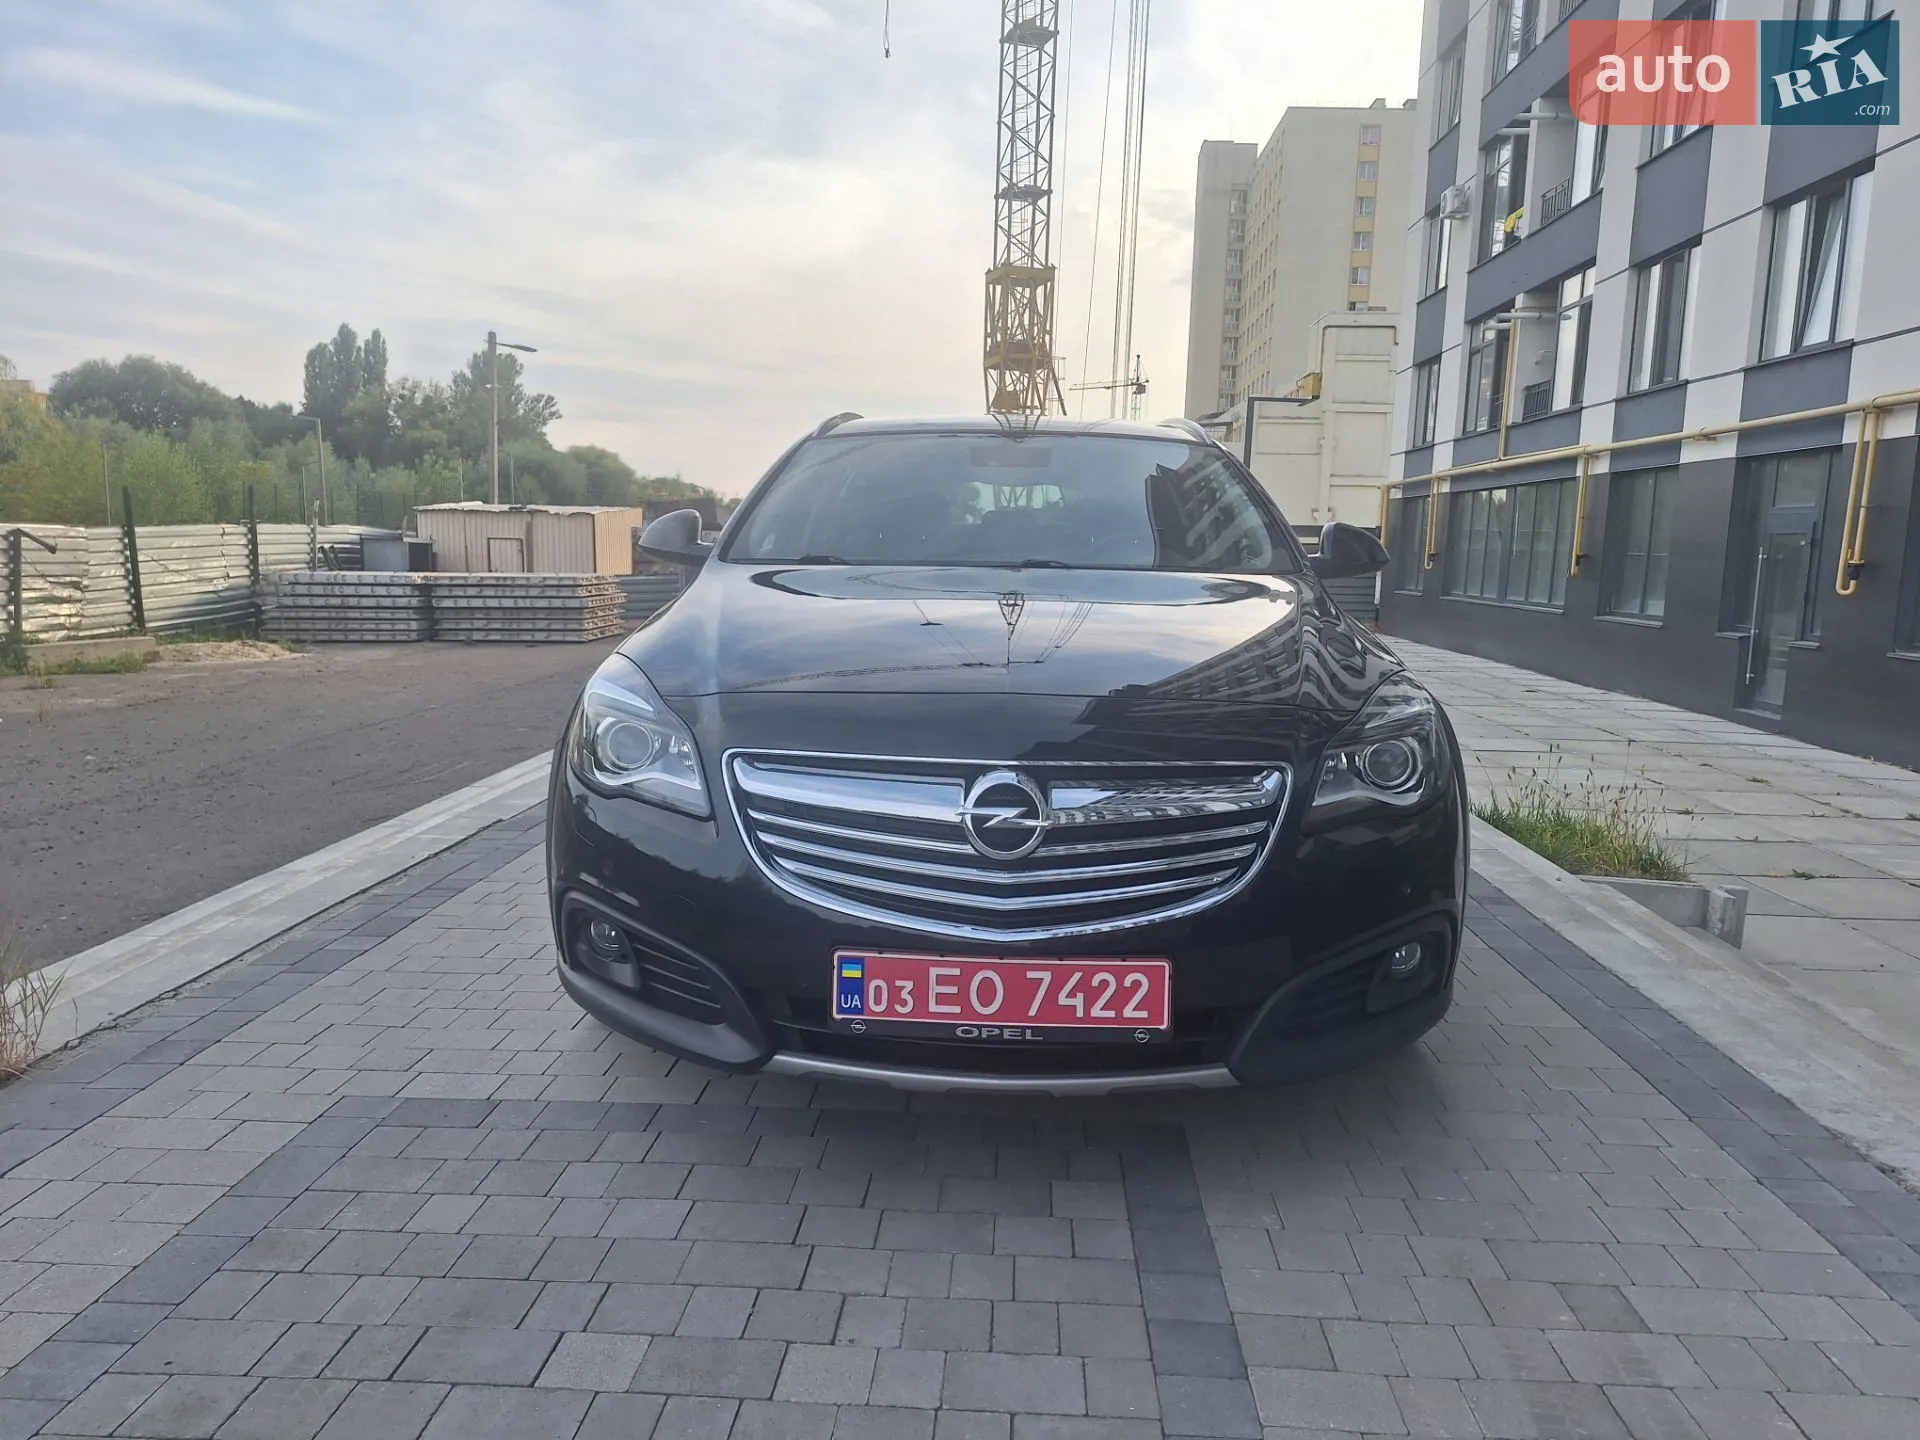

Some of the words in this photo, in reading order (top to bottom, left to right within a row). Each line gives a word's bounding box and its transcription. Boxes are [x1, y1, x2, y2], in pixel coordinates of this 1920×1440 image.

[868, 979, 915, 1014] 03
[928, 966, 1005, 1016] EO
[1026, 970, 1149, 1019] 7422
[841, 994, 861, 1009] UA
[955, 1026, 1043, 1040] OPEL
